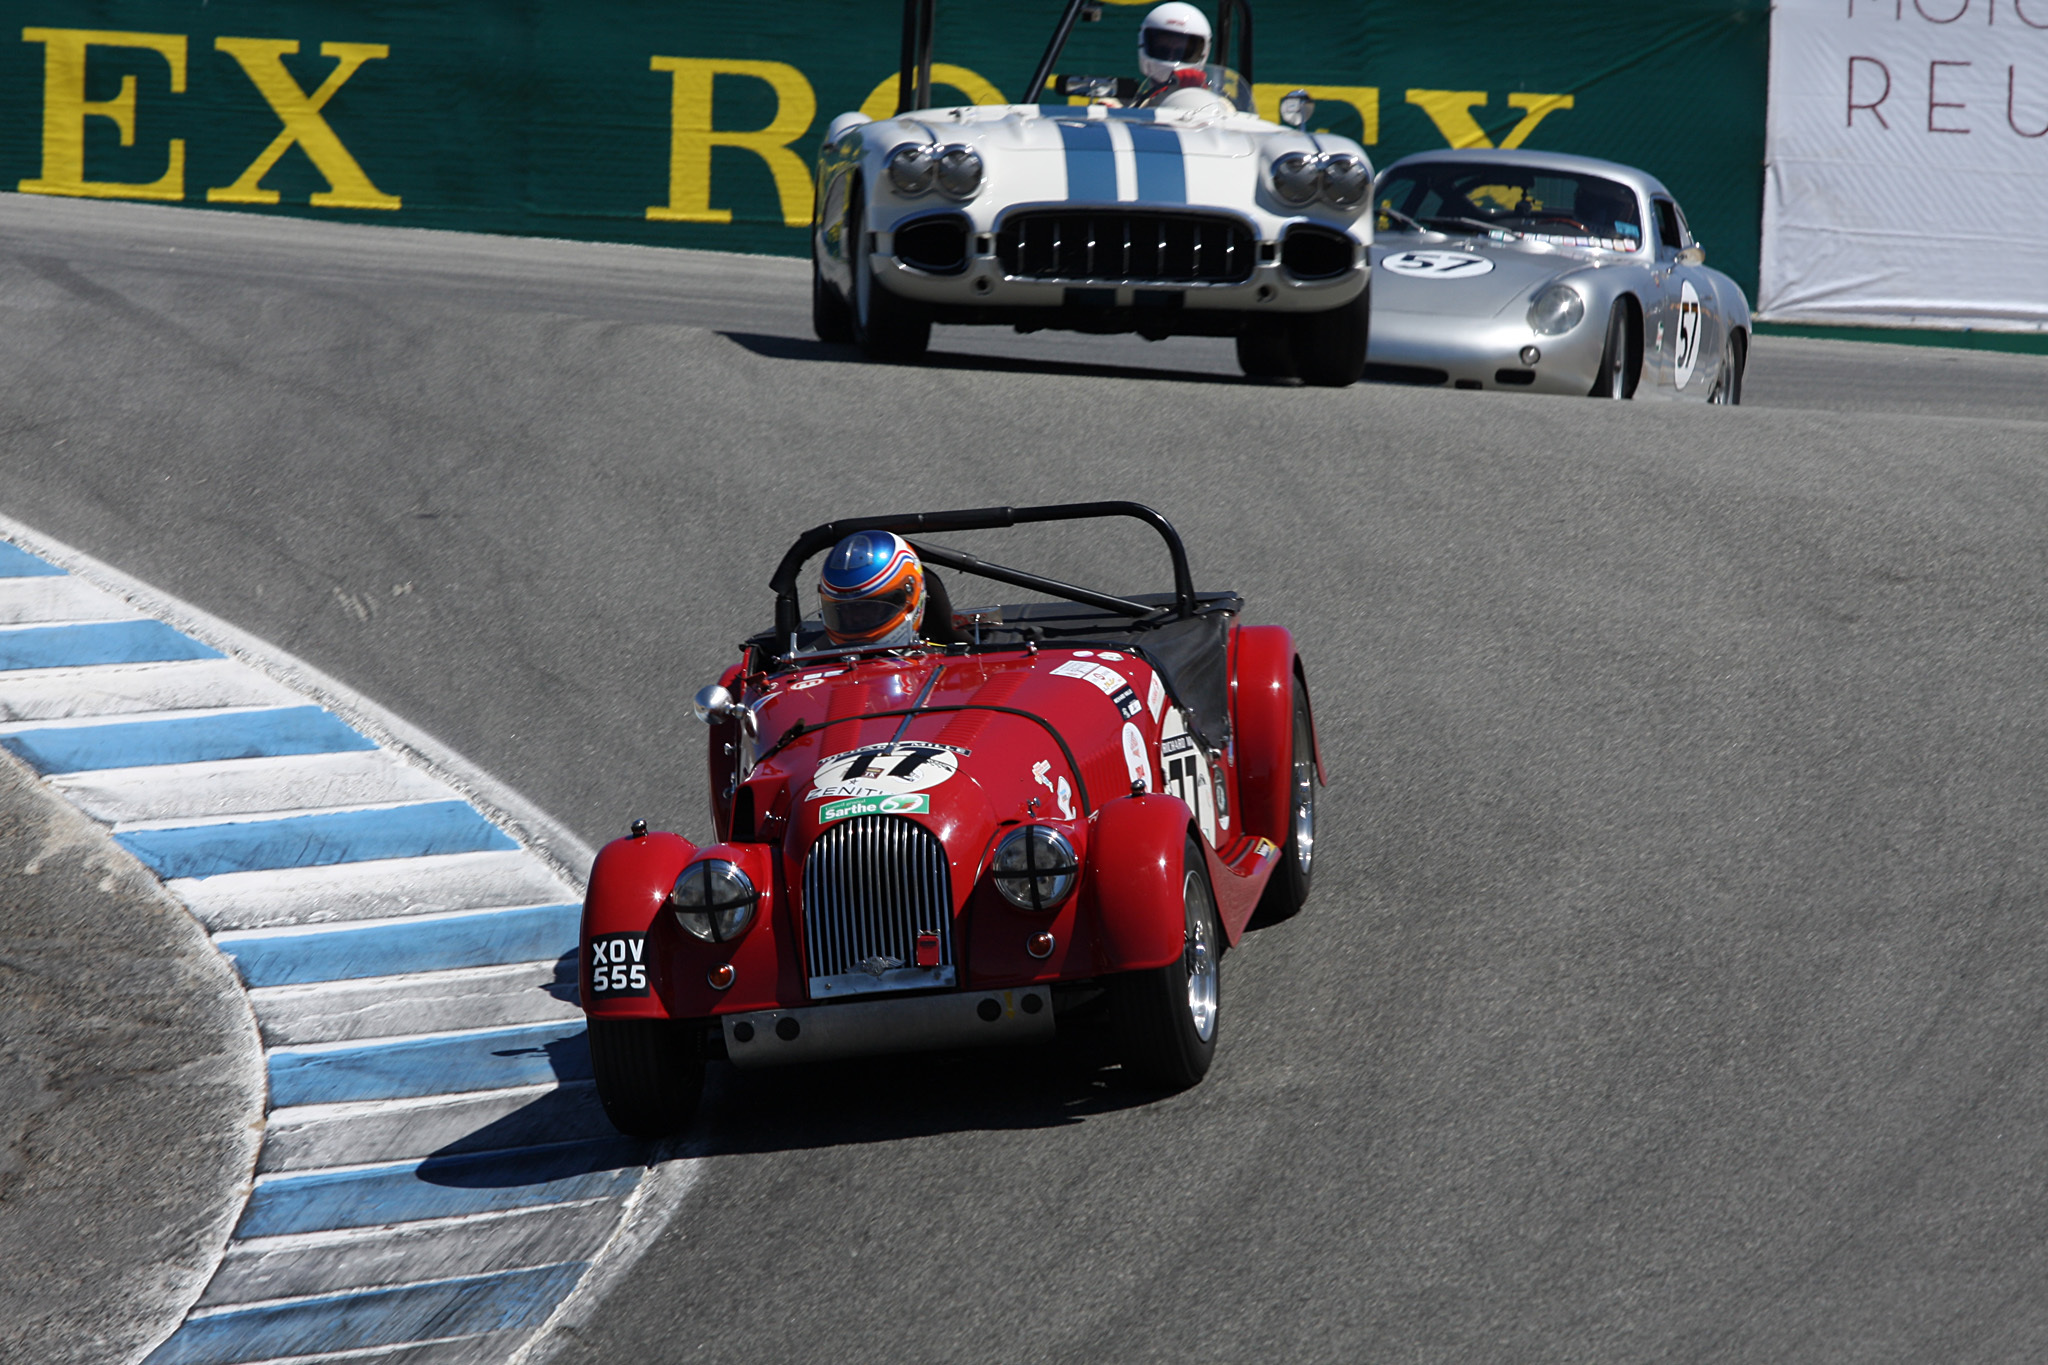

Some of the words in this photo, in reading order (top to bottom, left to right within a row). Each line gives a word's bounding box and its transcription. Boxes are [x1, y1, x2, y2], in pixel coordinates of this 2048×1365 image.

[1396, 254, 1484, 271] 57
[1677, 302, 1699, 368] 57
[830, 747, 948, 782] 77
[807, 786, 892, 800] ZENIT
[825, 803, 877, 819] Sarthe
[593, 938, 645, 966] XOV
[593, 964, 647, 992] 555
